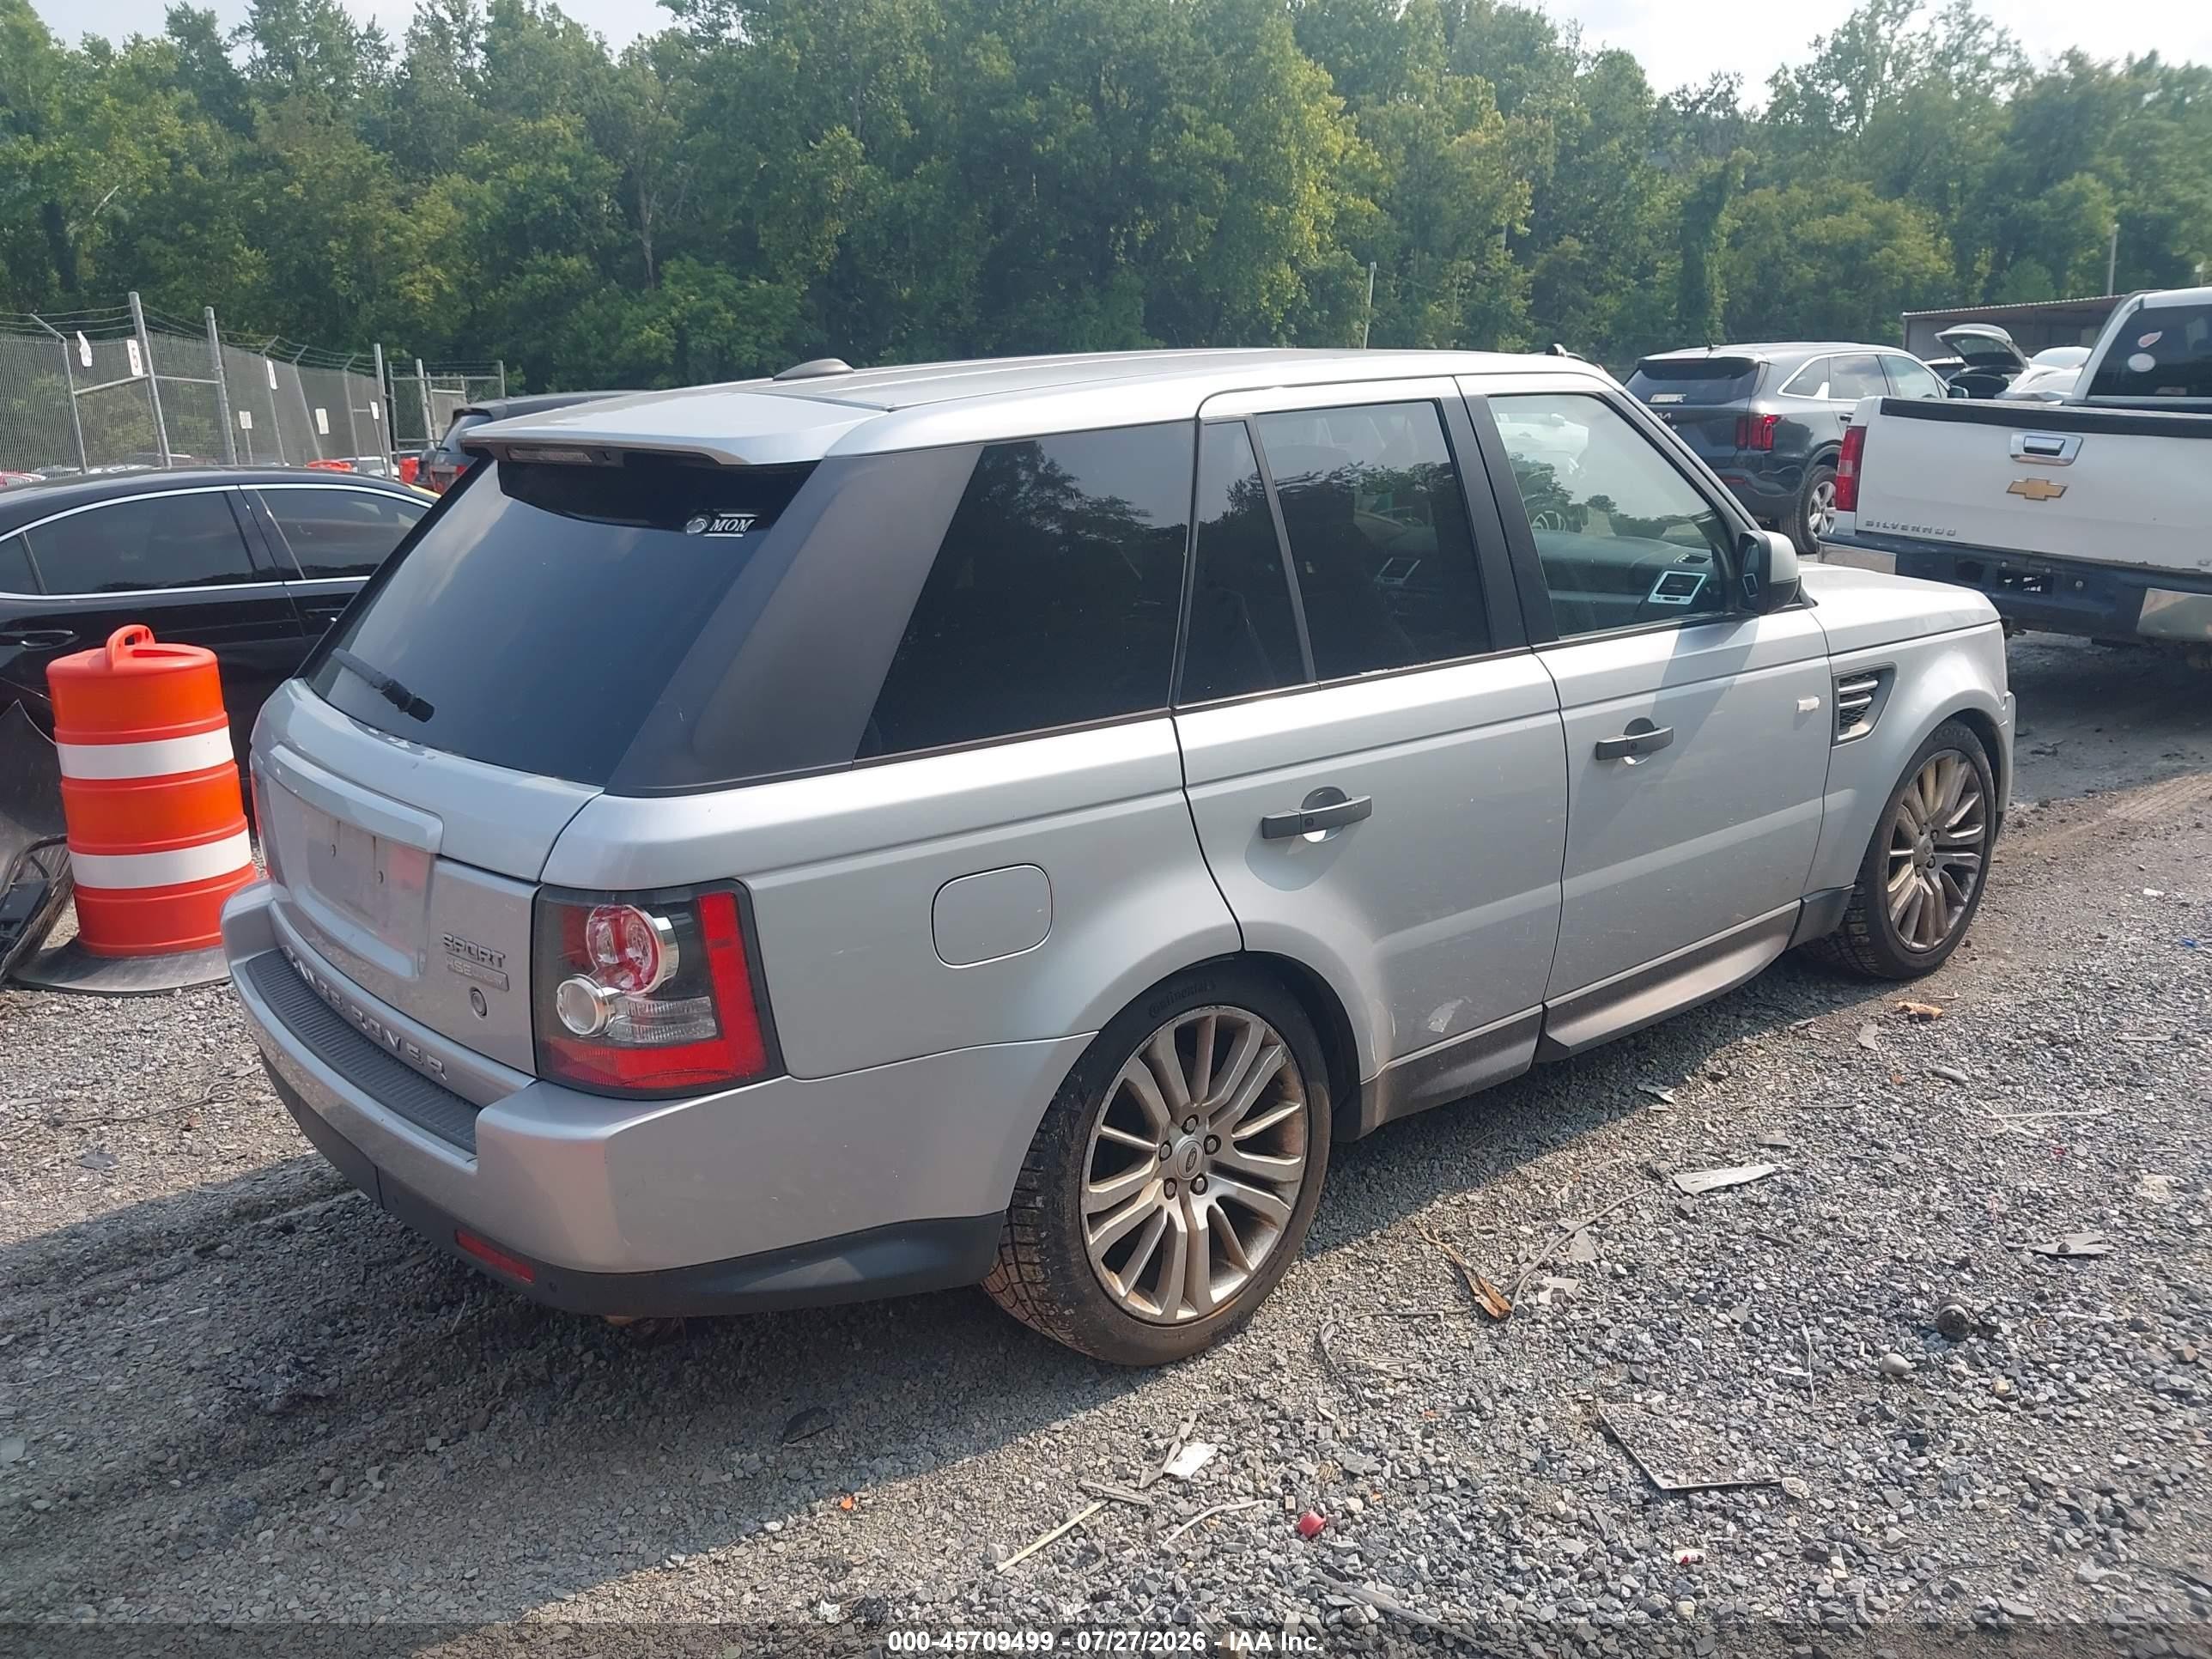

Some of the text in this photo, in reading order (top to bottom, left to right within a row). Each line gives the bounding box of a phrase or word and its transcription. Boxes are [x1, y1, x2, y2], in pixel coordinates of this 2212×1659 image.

[708, 519, 755, 532] MOM
[1865, 520, 1957, 537] SILVERADO
[443, 933, 506, 968] SPORT
[350, 1005, 447, 1081] ROVER
